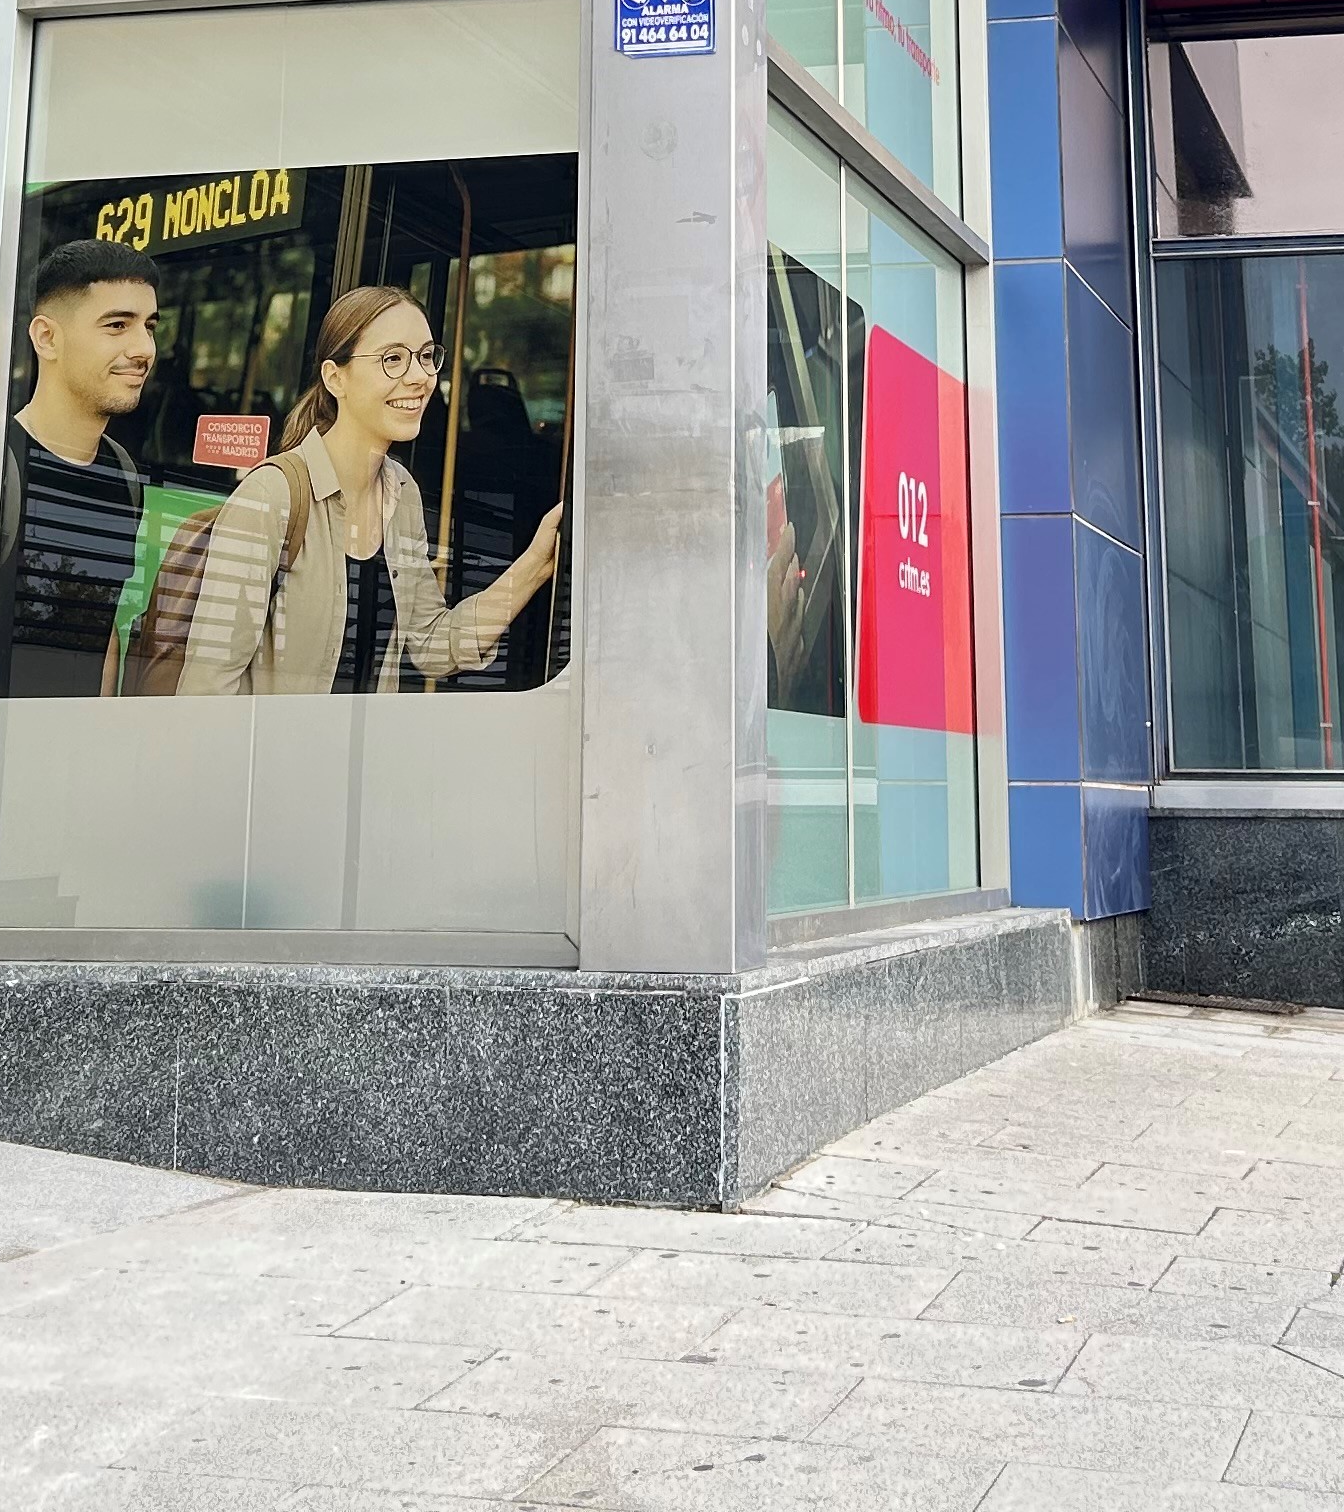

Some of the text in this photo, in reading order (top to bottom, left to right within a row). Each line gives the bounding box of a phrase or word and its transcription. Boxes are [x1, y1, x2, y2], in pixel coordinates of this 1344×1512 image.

[641, 3, 689, 16] ALARMA
[621, 17, 637, 27] CON
[621, 24, 709, 44] 91 464 64 04
[897, 17, 905, 47] tu
[906, 27, 940, 86] transporte
[96, 168, 290, 251] 629 MONCLOA
[208, 422, 262, 434] CONSORCIO
[201, 433, 260, 446] TRANSPORTES
[222, 445, 259, 458] MADRID
[898, 471, 928, 548] 012
[899, 556, 931, 598] crtm.es
